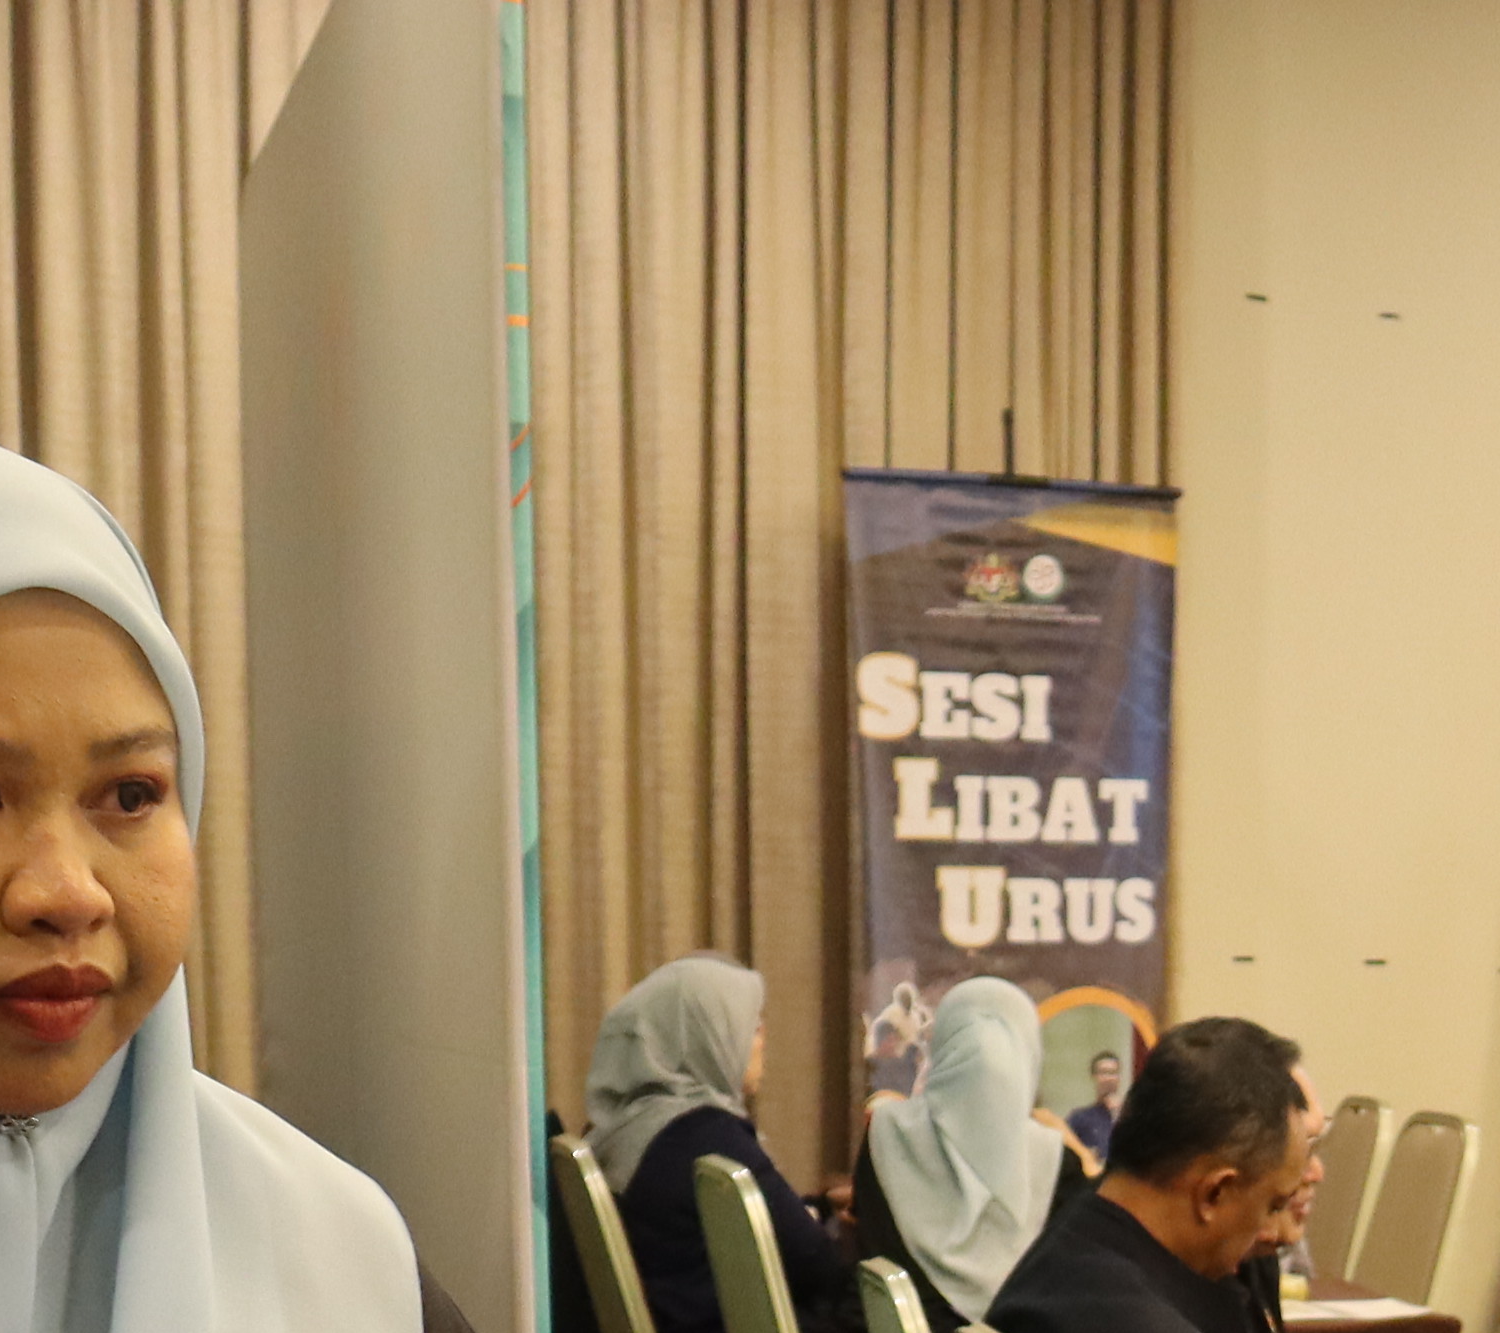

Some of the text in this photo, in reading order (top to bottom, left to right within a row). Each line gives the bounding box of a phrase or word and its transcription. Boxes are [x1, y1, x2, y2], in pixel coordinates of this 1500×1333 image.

[856, 651, 1052, 743] SESI
[894, 757, 1149, 843] LIBAT
[937, 866, 1156, 948] URUS
